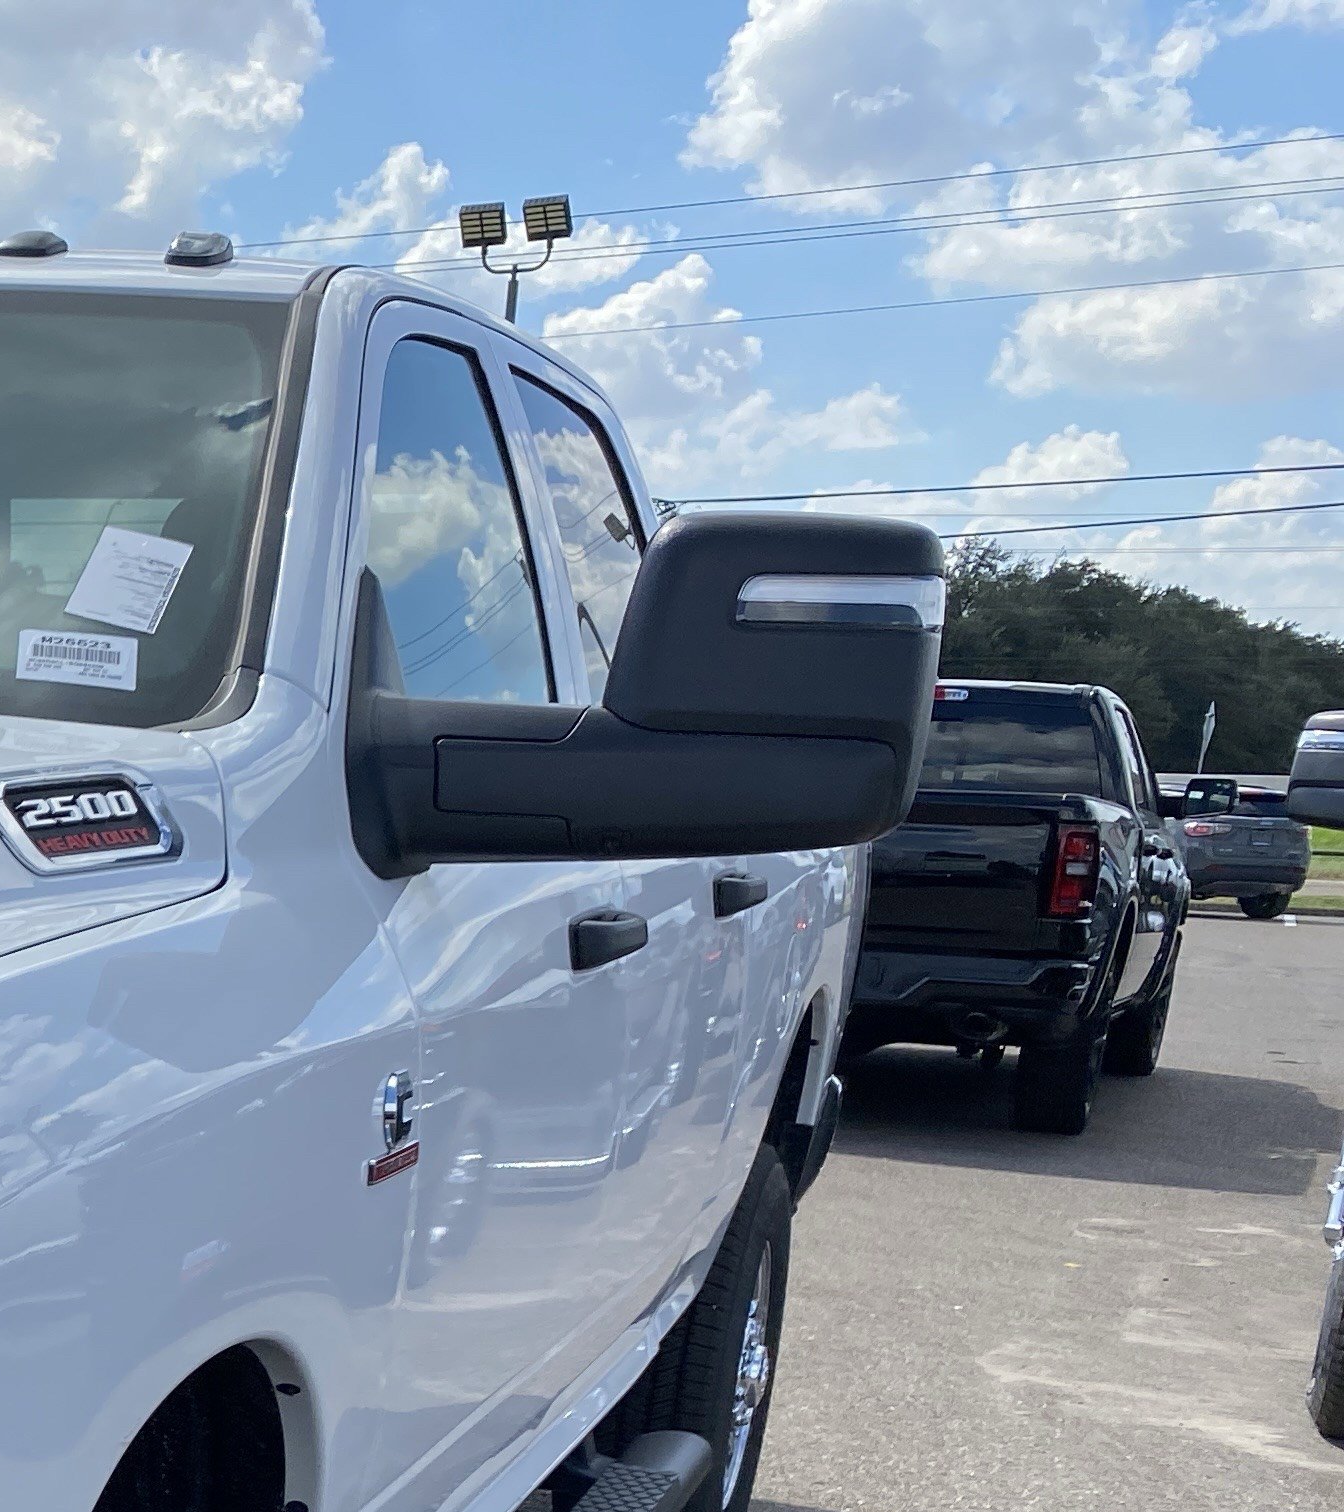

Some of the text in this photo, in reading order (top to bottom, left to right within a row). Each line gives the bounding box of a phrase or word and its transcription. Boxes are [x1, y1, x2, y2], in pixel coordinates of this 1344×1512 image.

[14, 789, 139, 830] 2500
[35, 826, 150, 852] HEAVY DUTY
